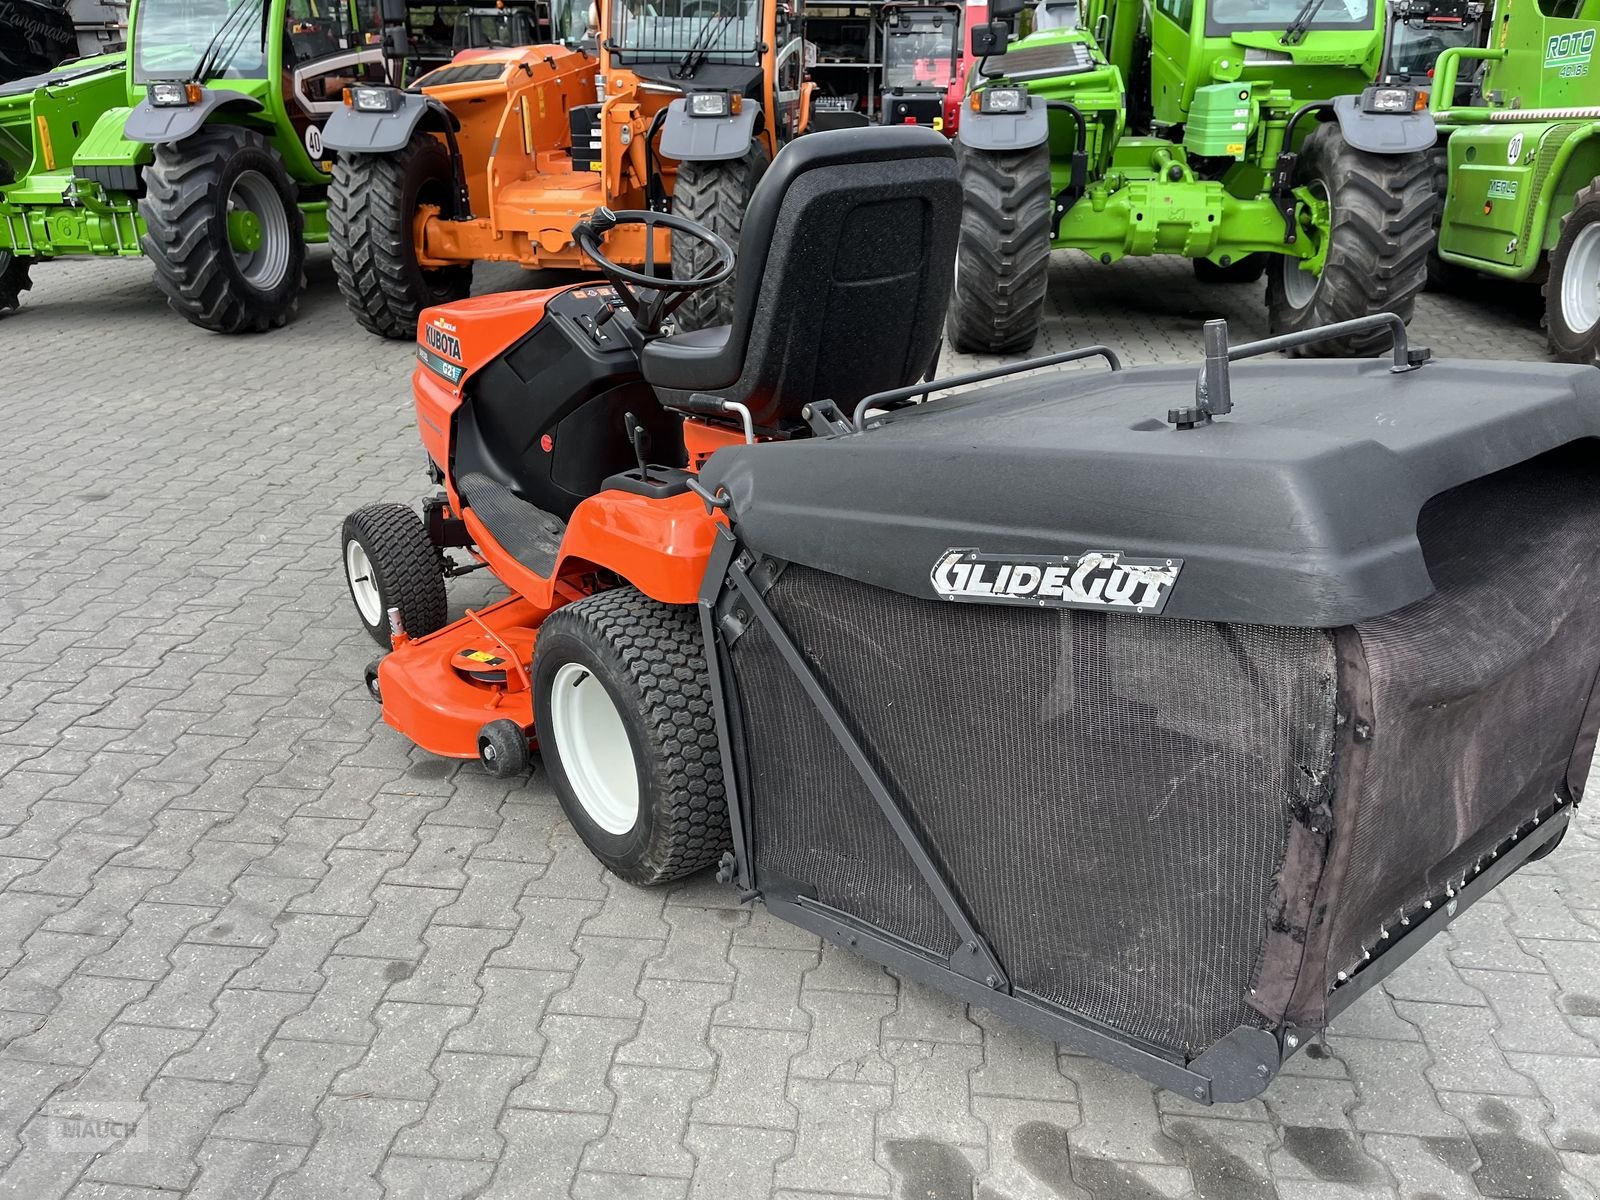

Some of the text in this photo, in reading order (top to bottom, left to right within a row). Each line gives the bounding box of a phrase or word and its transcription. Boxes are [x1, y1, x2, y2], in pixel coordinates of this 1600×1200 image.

[1546, 28, 1596, 59] ROTO
[309, 132, 320, 152] 40
[1508, 138, 1520, 158] 20
[1490, 180, 1518, 194] MERLO
[425, 323, 462, 361] KUBOTA
